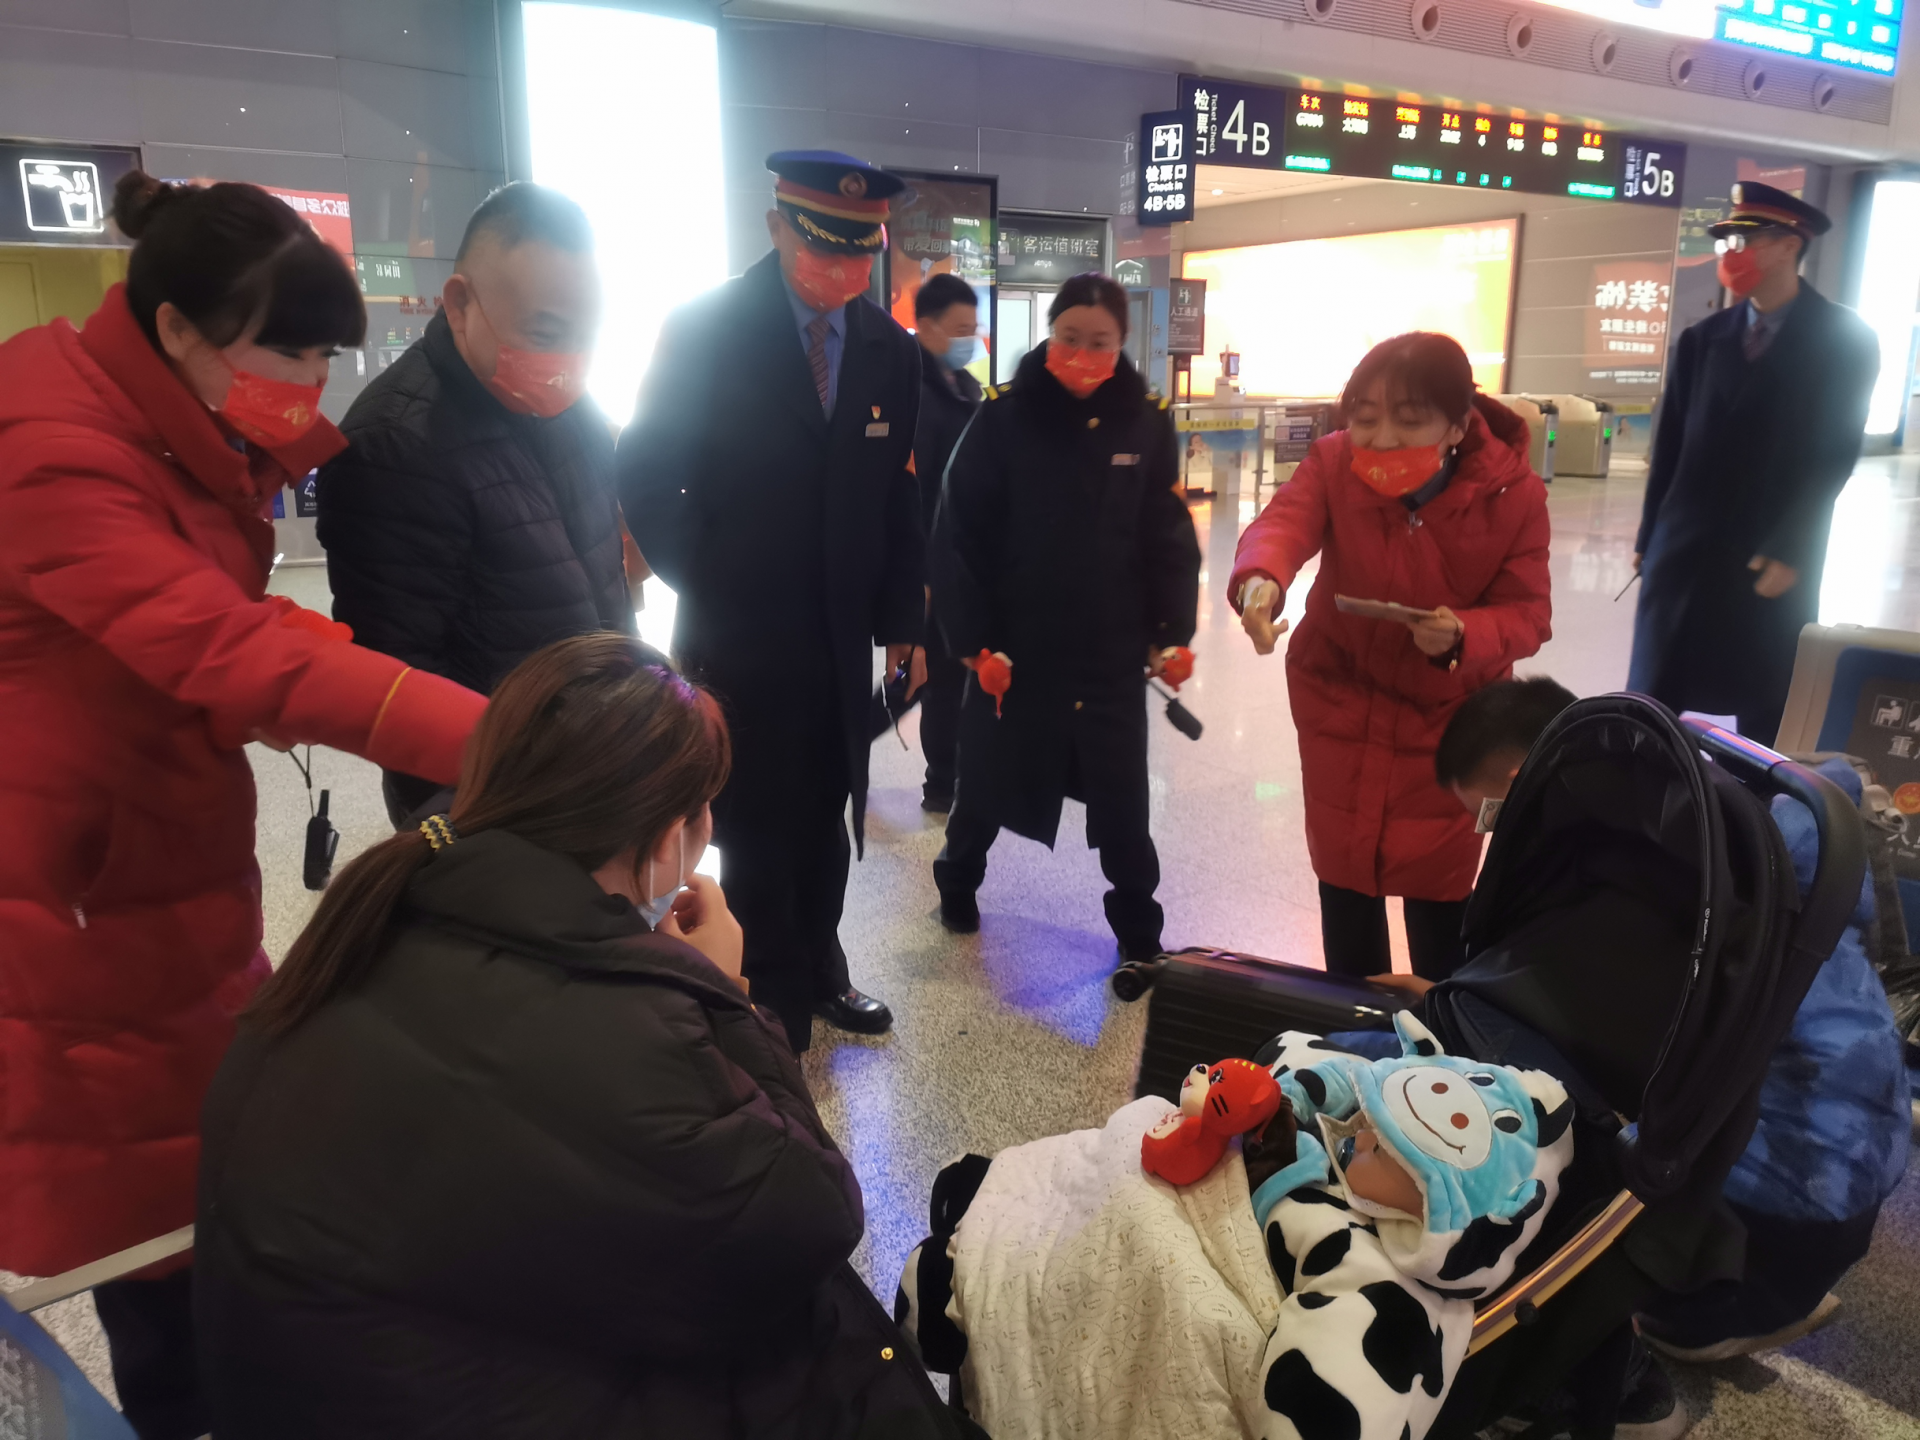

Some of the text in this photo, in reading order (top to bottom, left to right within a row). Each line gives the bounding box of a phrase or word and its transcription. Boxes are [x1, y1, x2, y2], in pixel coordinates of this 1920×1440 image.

[1194, 88, 1210, 156] 检票口
[1221, 99, 1271, 156] 4B
[1145, 164, 1187, 183] 检票口
[1641, 152, 1675, 198] 5B
[1023, 235, 1099, 257] 客运值班室
